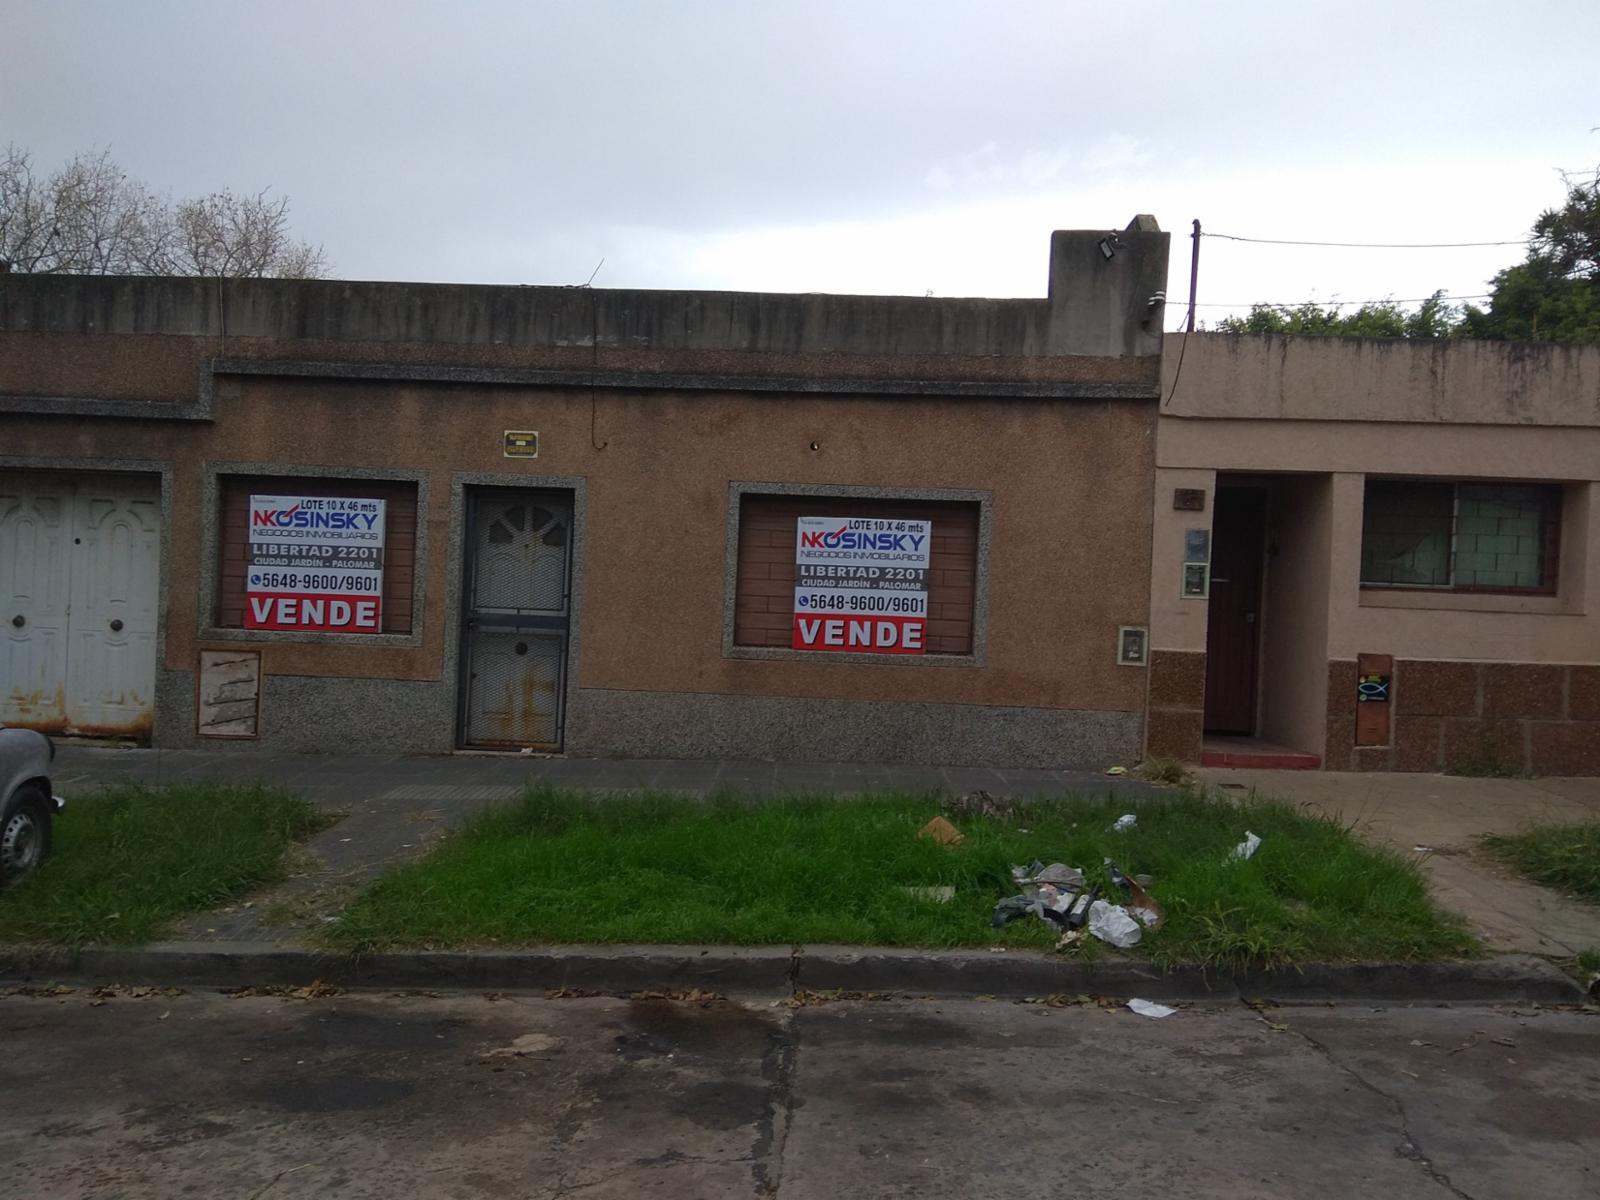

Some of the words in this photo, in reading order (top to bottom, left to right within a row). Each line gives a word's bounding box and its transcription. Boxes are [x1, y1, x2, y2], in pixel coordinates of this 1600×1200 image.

[301, 500, 323, 510] LOTE
[327, 501, 337, 510] 10
[339, 502, 345, 511] X
[348, 502, 358, 511] 46
[361, 504, 376, 512] mts
[849, 520, 871, 530] LOTE
[874, 521, 884, 530] 10
[887, 522, 892, 531] X
[895, 522, 905, 532] 46
[908, 524, 923, 532] mts
[253, 529, 304, 537] NEGOCIOS
[306, 531, 378, 540] INMOBILIARIOS
[253, 544, 333, 556] LIBERTAD
[338, 547, 377, 558] 2201
[801, 551, 851, 559] NEGOCIOS
[853, 552, 924, 561] INMOBILIARIOS
[254, 557, 288, 566] CIUDAD
[801, 566, 880, 578] LIBERTAD
[885, 569, 924, 579] 2201
[263, 573, 377, 591] 5648-9600/9601
[802, 579, 835, 587] CIUDAD
[879, 582, 921, 590] PALOMAR
[810, 594, 924, 612] 5648-9600/9601
[251, 598, 375, 627] VENDE
[799, 619, 922, 648] VENDE
